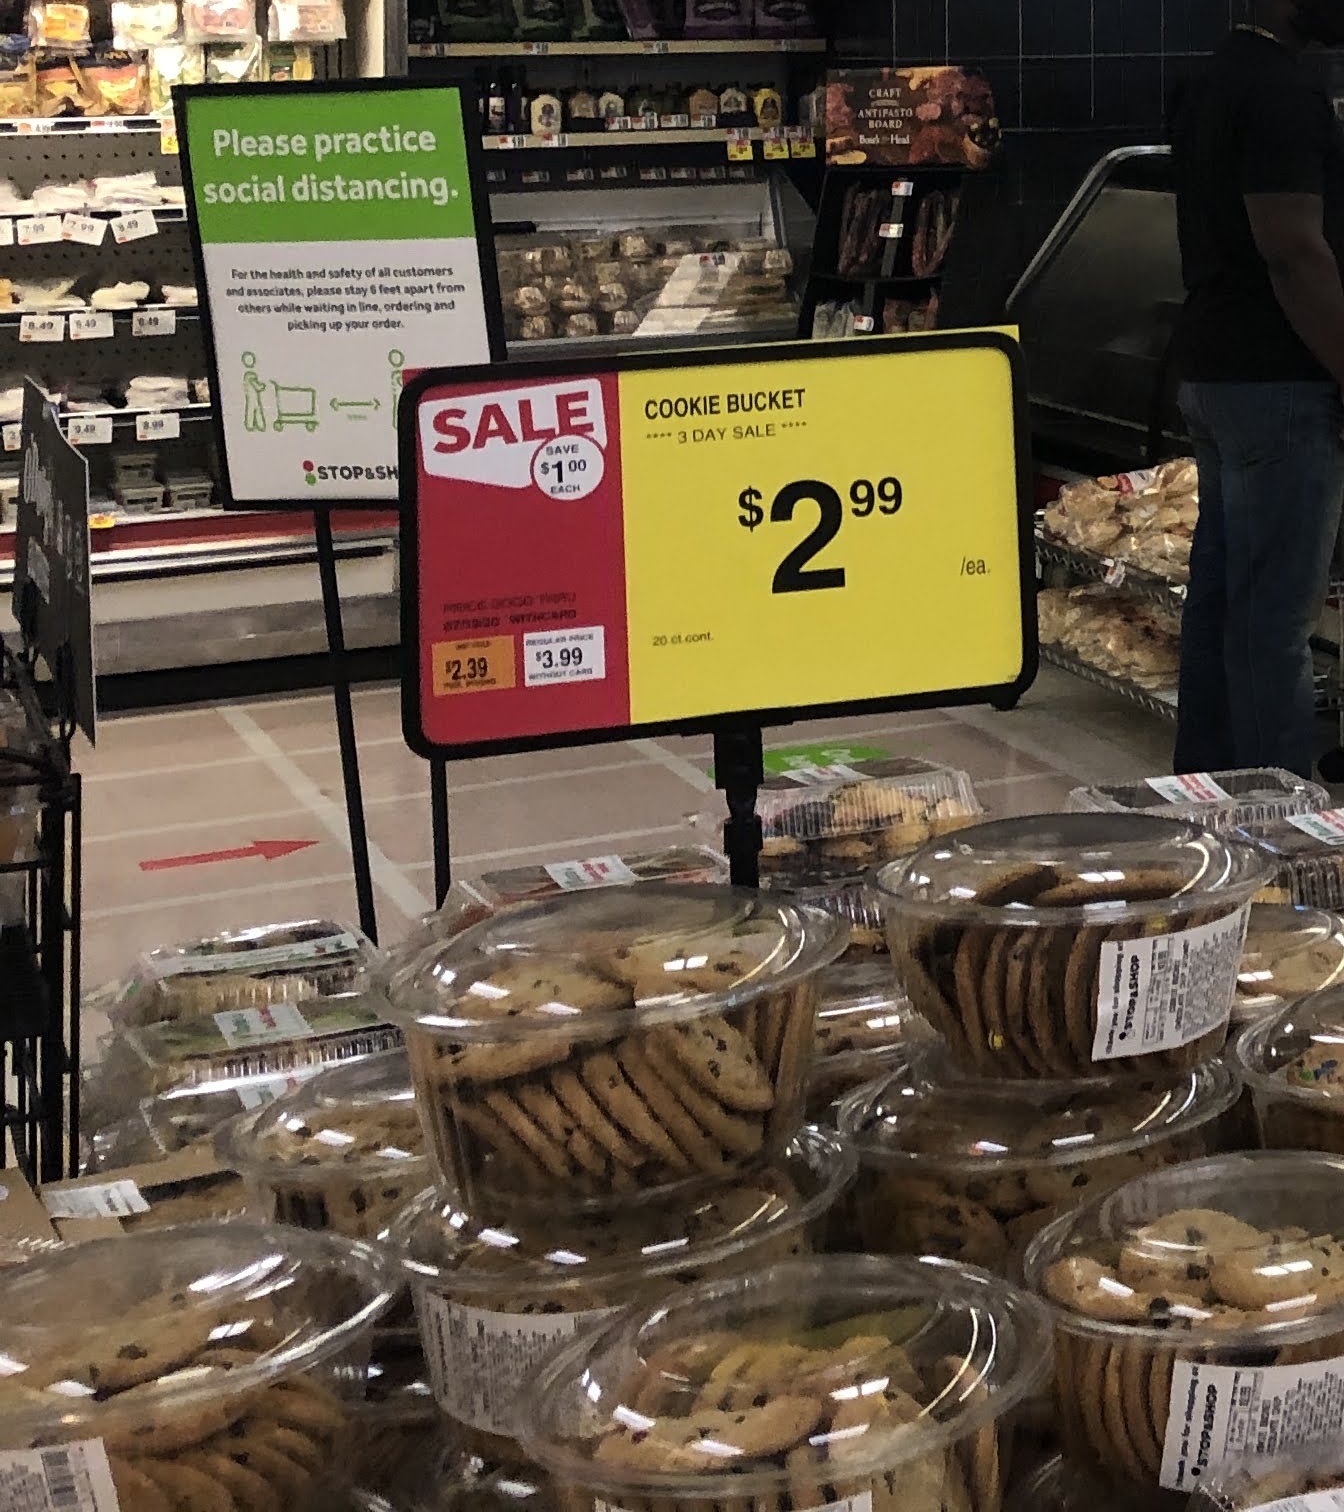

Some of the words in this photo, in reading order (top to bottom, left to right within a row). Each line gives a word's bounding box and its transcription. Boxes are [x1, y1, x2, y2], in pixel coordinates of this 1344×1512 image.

[213, 128, 308, 157] Please
[314, 124, 437, 162] practice
[203, 174, 285, 204] social
[291, 171, 459, 206] distancing.
[231, 268, 248, 280] For
[249, 268, 268, 280] the
[269, 268, 304, 280] health
[306, 268, 327, 279] and
[328, 267, 362, 281] safety
[365, 267, 376, 278] of
[378, 266, 391, 278] all
[392, 266, 453, 278] customers
[306, 284, 342, 298] please
[343, 285, 368, 298] stay
[378, 283, 401, 295] feet
[403, 283, 435, 297] apart
[436, 282, 465, 293] from
[237, 302, 272, 314] others
[273, 302, 302, 313] while
[304, 301, 345, 316] waiting
[346, 301, 357, 312] in
[384, 300, 432, 314] ordering
[434, 299, 455, 311] and
[287, 319, 327, 332] picking
[329, 321, 343, 332] up
[344, 320, 370, 332] your
[644, 394, 721, 421] COOKIE
[726, 388, 807, 414] BUCKET
[432, 390, 595, 454] SALE
[677, 430, 688, 445] 3
[692, 427, 728, 443] DAY
[732, 423, 777, 439] SALE
[545, 443, 580, 456] SAVE
[317, 464, 399, 482] STOP&SH
[549, 483, 581, 495] EACH
[960, 555, 992, 578] /ea.
[652, 635, 667, 647] 20
[445, 656, 488, 681] $2.39
[535, 646, 583, 669] $3.99
[1123, 954, 1140, 1031] STOP&SHOP
